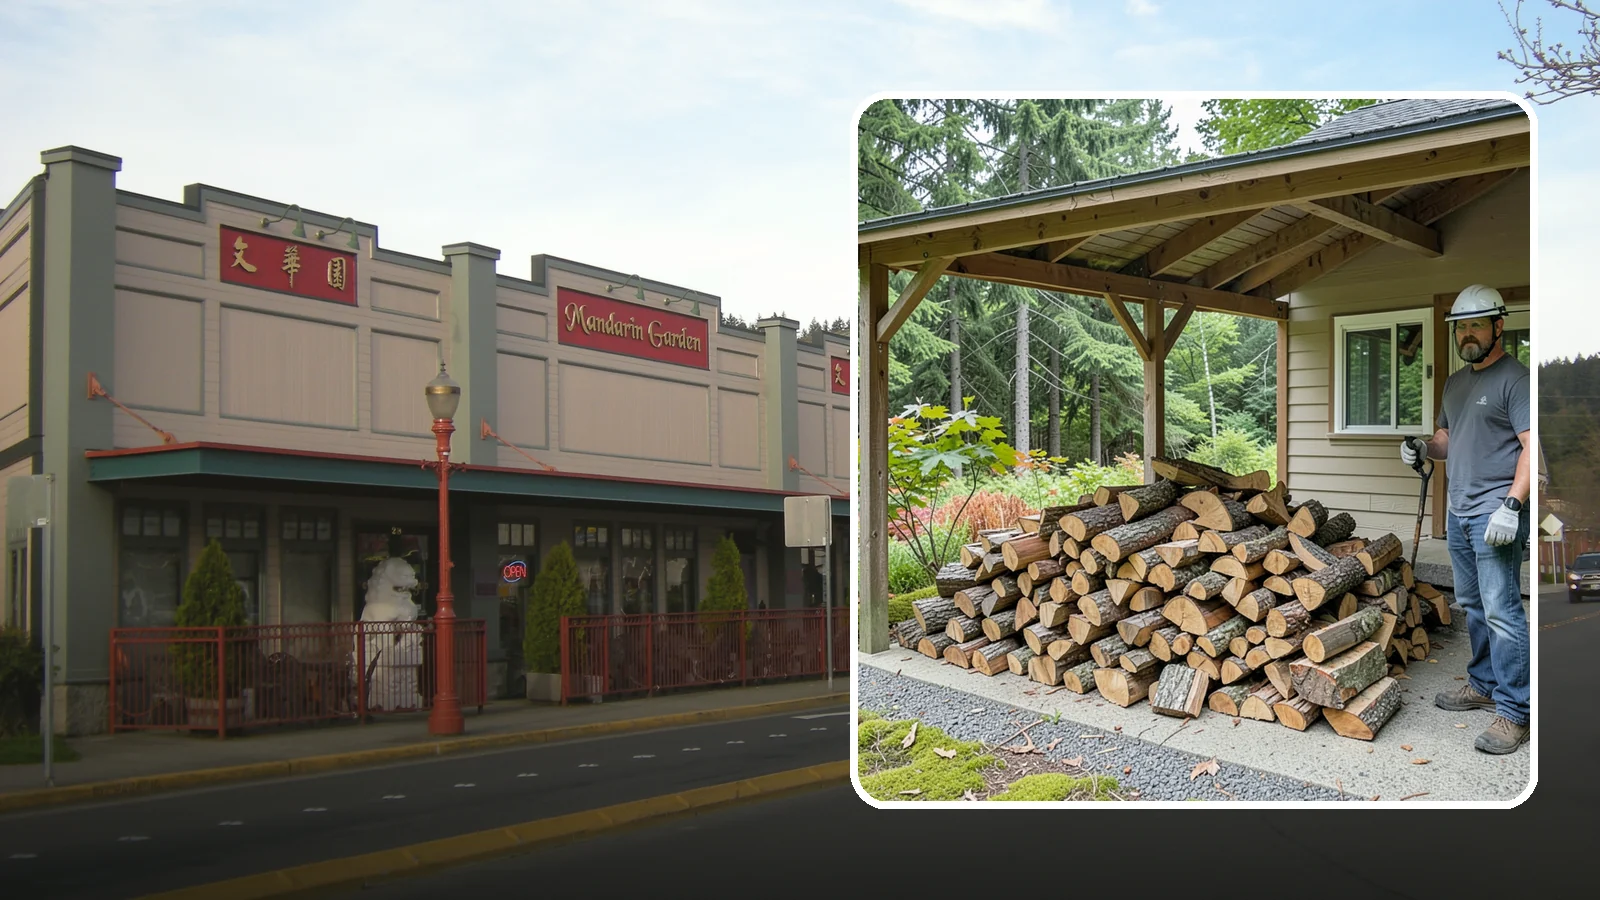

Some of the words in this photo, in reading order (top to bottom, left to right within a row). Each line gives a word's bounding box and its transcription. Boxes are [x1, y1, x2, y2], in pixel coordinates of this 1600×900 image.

[230, 235, 346, 291] 文華園
[564, 302, 644, 341] Mandarin
[647, 320, 702, 353] Garden
[503, 565, 527, 578] OPEN
